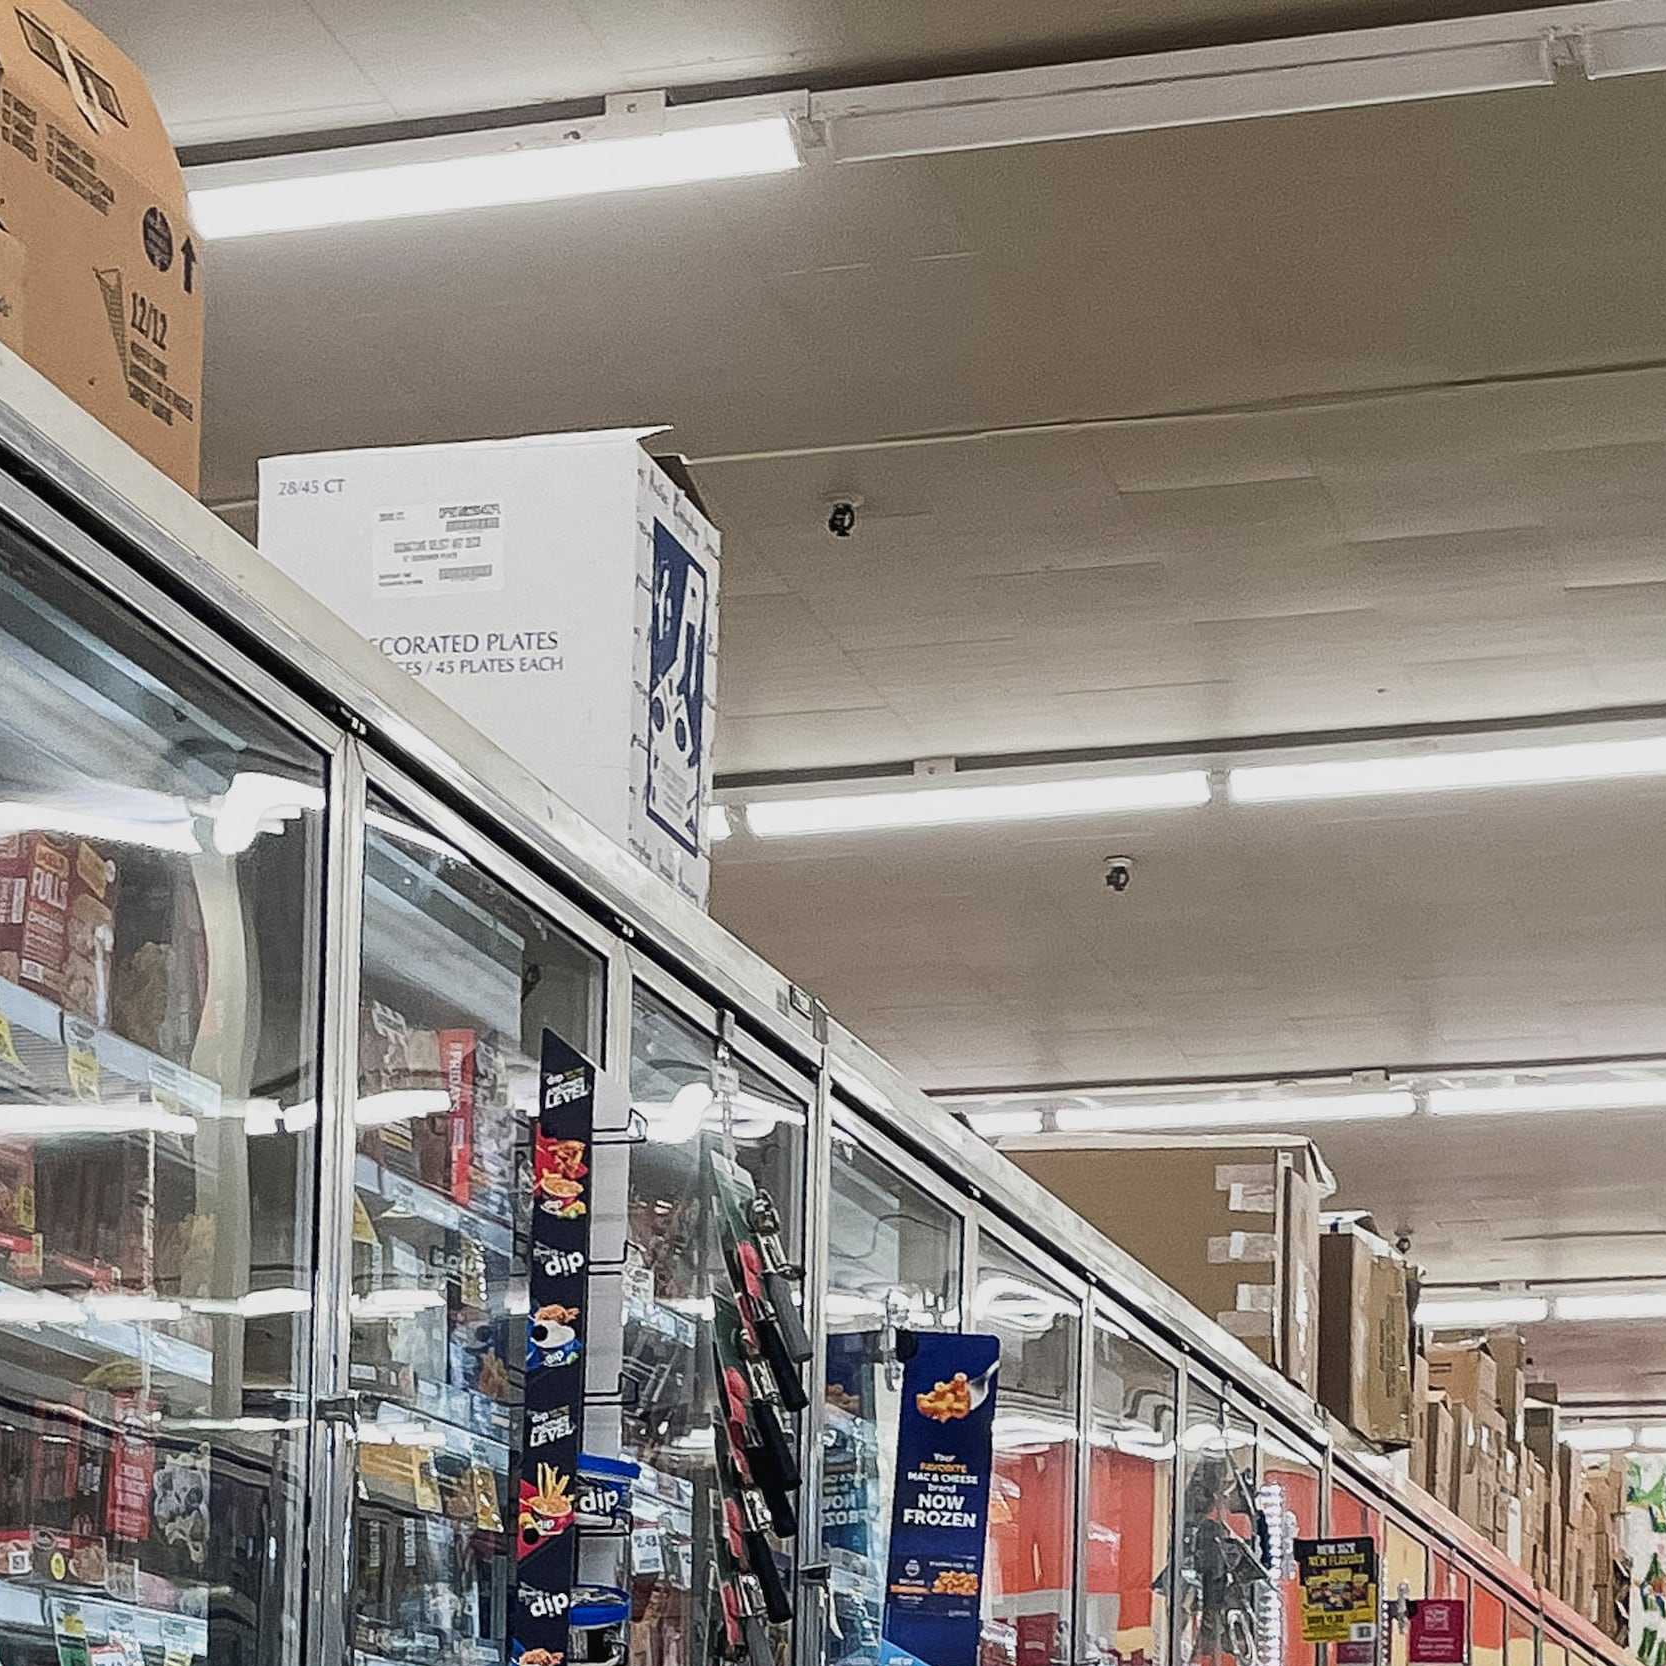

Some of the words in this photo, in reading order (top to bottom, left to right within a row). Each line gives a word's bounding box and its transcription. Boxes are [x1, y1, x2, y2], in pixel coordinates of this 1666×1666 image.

[132, 292, 168, 351] 12/12
[277, 479, 320, 497] 28/45
[324, 478, 346, 494] CT
[486, 630, 559, 653] PLATES
[435, 660, 455, 674] 45
[459, 657, 515, 674] PLATES
[519, 655, 564, 672] EACH
[545, 1083, 589, 1111] LEVEL
[544, 1251, 585, 1278] dip
[529, 1420, 574, 1449] LEVEL
[907, 1471, 930, 1483] MAC
[941, 1473, 979, 1485] CHEESE
[927, 1482, 957, 1494] brand
[579, 1487, 620, 1516] dip
[917, 1493, 966, 1511] NOW
[902, 1508, 977, 1528] FROZEN
[530, 1587, 570, 1619] dip
